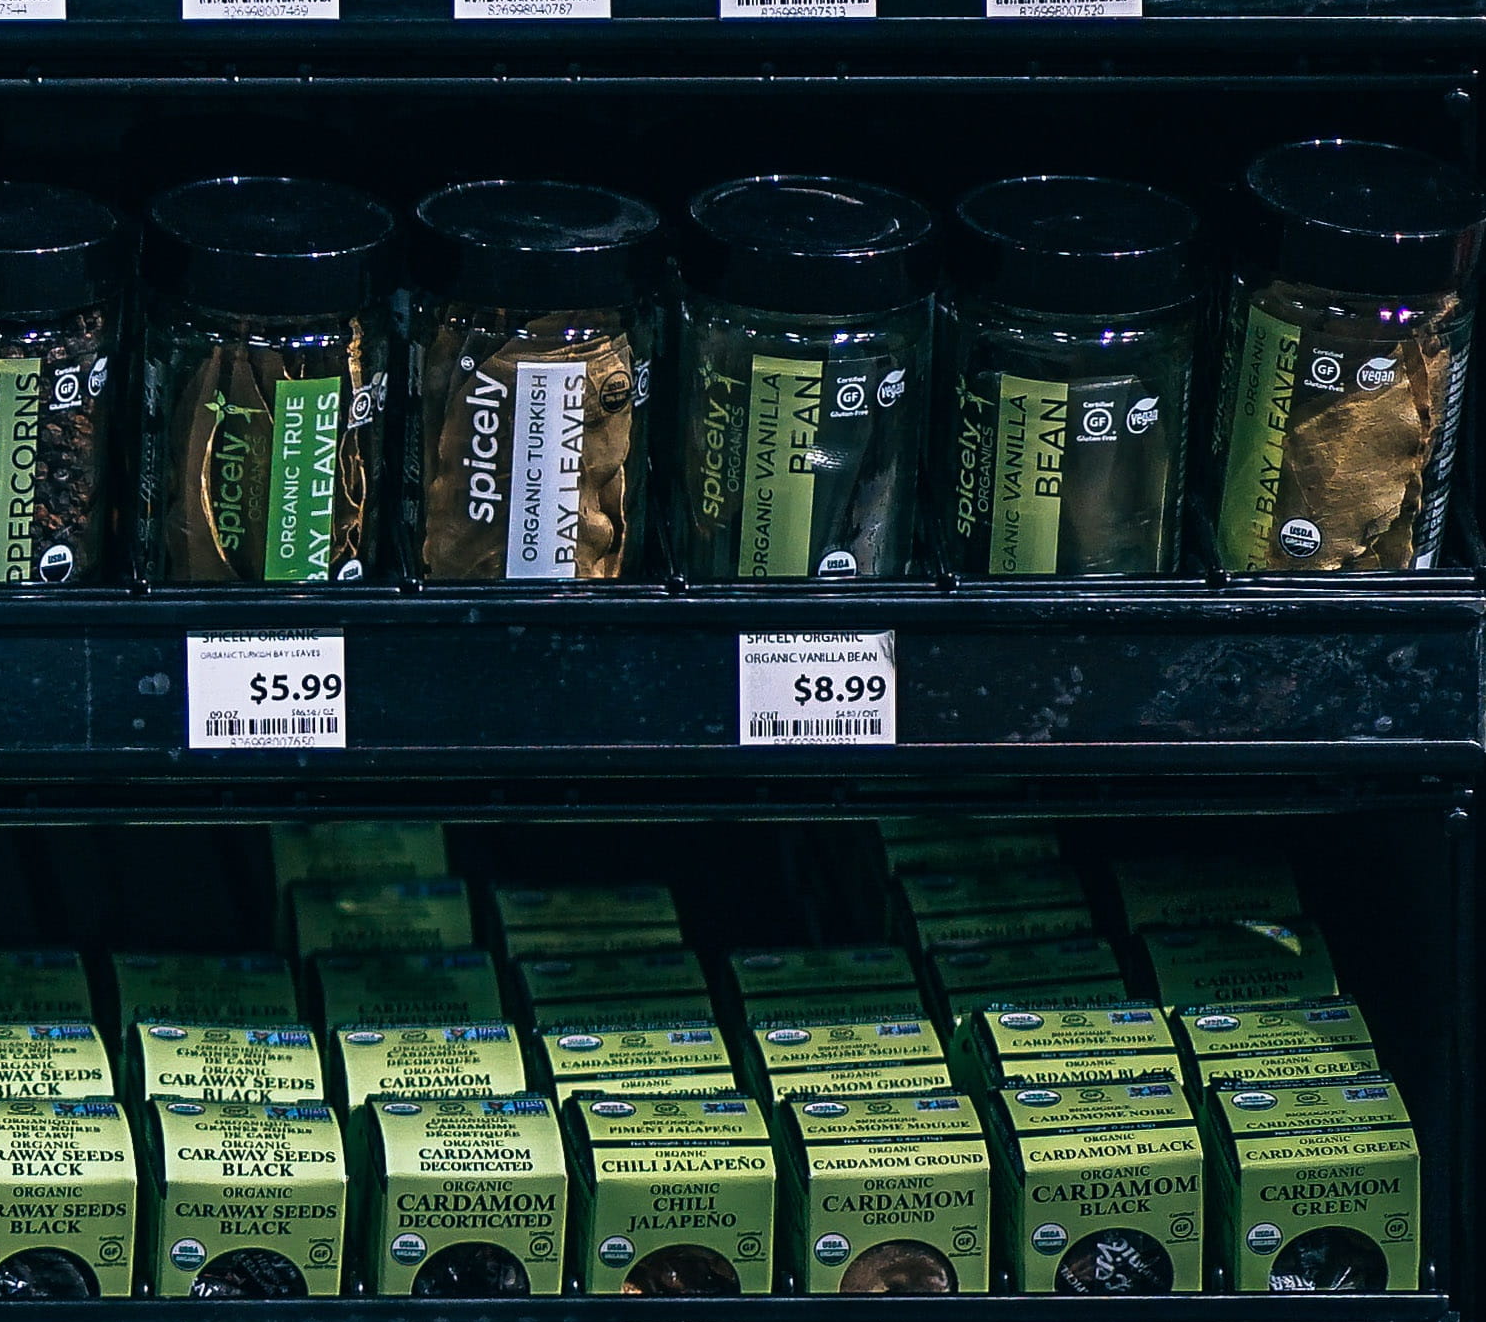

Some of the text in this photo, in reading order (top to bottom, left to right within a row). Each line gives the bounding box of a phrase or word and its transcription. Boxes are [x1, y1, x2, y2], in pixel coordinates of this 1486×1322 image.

[466, 368, 508, 524] spicely
[522, 373, 547, 561] ORGANIC TURKISH
[556, 373, 588, 564] BAY LEAVES
[1036, 398, 1068, 498] BEAN
[795, 674, 886, 706] $8.99
[626, 1211, 736, 1233] JALAPEÑO
[1260, 1178, 1401, 1201] CARDAMOM
[10, 1220, 82, 1234] BLACK
